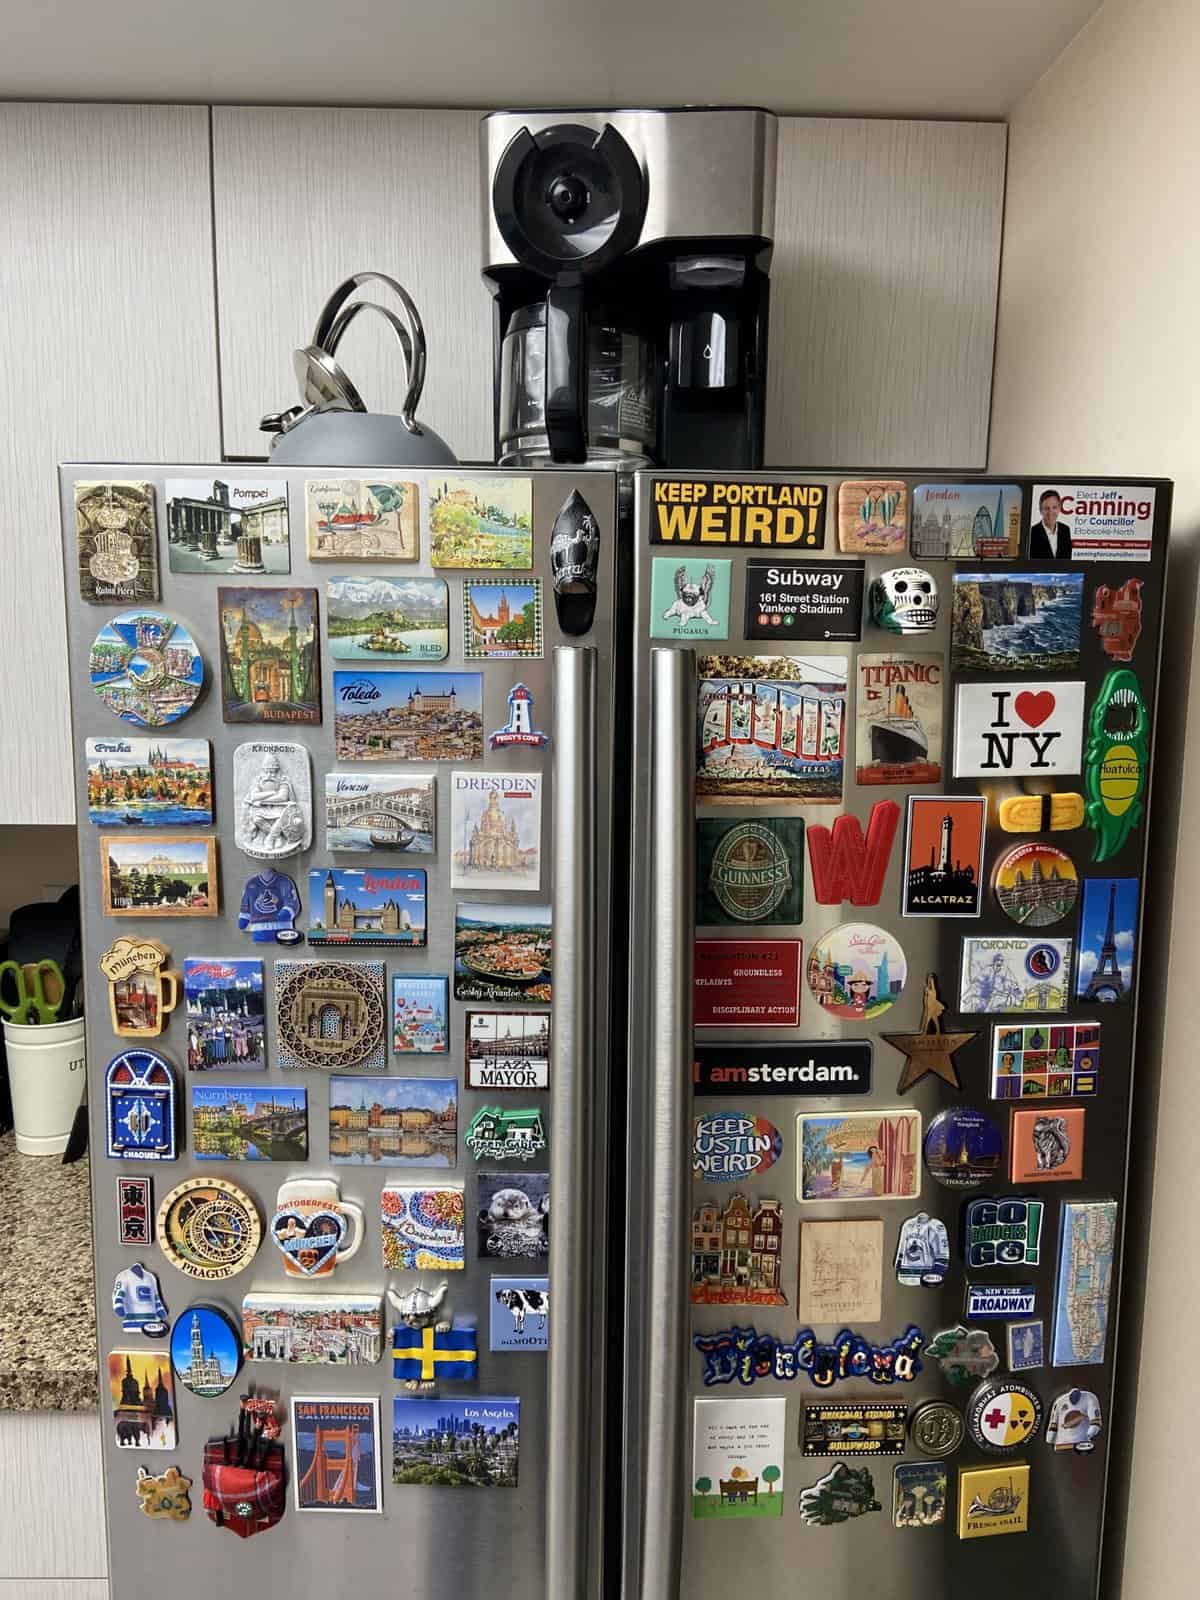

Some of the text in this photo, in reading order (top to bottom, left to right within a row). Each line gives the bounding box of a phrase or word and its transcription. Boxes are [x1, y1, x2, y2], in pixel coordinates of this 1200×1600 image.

[233, 488, 269, 500] Pompei
[655, 482, 823, 506] KEEP PORTLAND
[1059, 494, 1152, 520] Canning
[657, 504, 819, 545] WEIRD!
[1089, 517, 1135, 526] Councillor
[766, 568, 844, 590] Subway
[759, 593, 850, 604] 161 Street Station
[758, 603, 844, 614] Yankee Stadium
[860, 664, 941, 687] TITANIC
[340, 685, 382, 701] Toledo
[263, 710, 316, 720] BUDAPEST
[990, 691, 1011, 728] I
[95, 742, 132, 753] Praha
[801, 766, 833, 774] TEXAS
[455, 776, 538, 791] DRESDEN
[718, 865, 784, 885] GUINNESS
[363, 875, 421, 893] London
[912, 895, 974, 904] ALCATRAZ
[976, 940, 1028, 950] TORONTO
[108, 950, 157, 976] München
[733, 968, 784, 977] GROUNDLESS
[712, 1006, 796, 1014] DISCIPLINARY ACTION
[484, 1060, 532, 1070] PLAZA
[479, 1070, 537, 1086] MAYOR
[696, 1119, 754, 1135] KEEP
[122, 1151, 161, 1160] CHAOUEN
[693, 1154, 762, 1173] WEIRD
[278, 1199, 338, 1211] OKTOBERFEST
[181, 1262, 234, 1279] PRAGUE
[972, 1298, 1032, 1311] BROADWAY
[297, 1405, 370, 1416] SAN FRANCISCO
